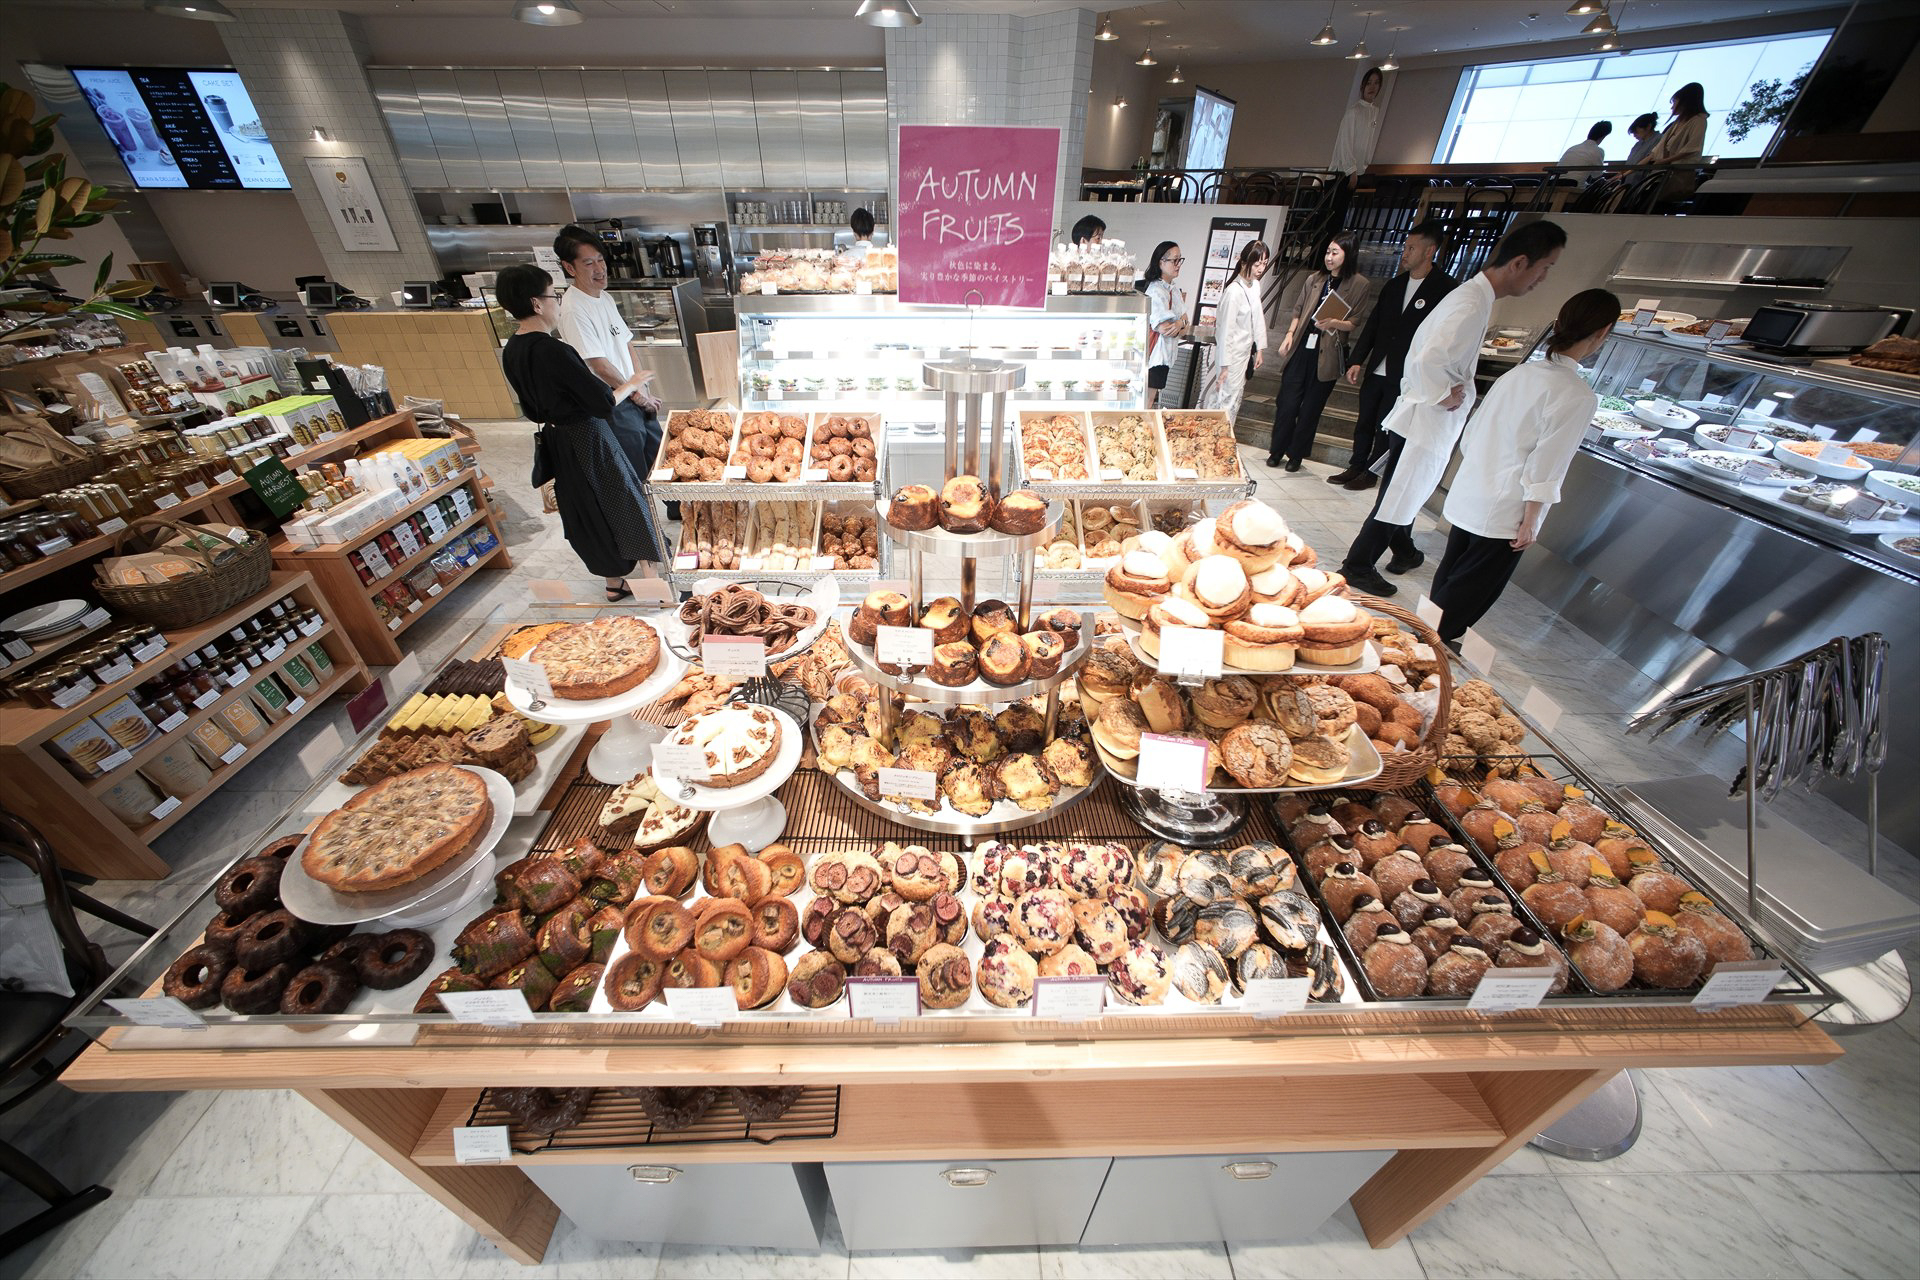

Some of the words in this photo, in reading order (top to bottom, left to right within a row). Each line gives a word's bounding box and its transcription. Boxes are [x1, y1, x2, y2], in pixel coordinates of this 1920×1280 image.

[915, 166, 1037, 202] AUTUMN
[922, 208, 1025, 246] FRUITS
[259, 468, 283, 489] AUTUMN
[262, 474, 293, 498] HARVEST
